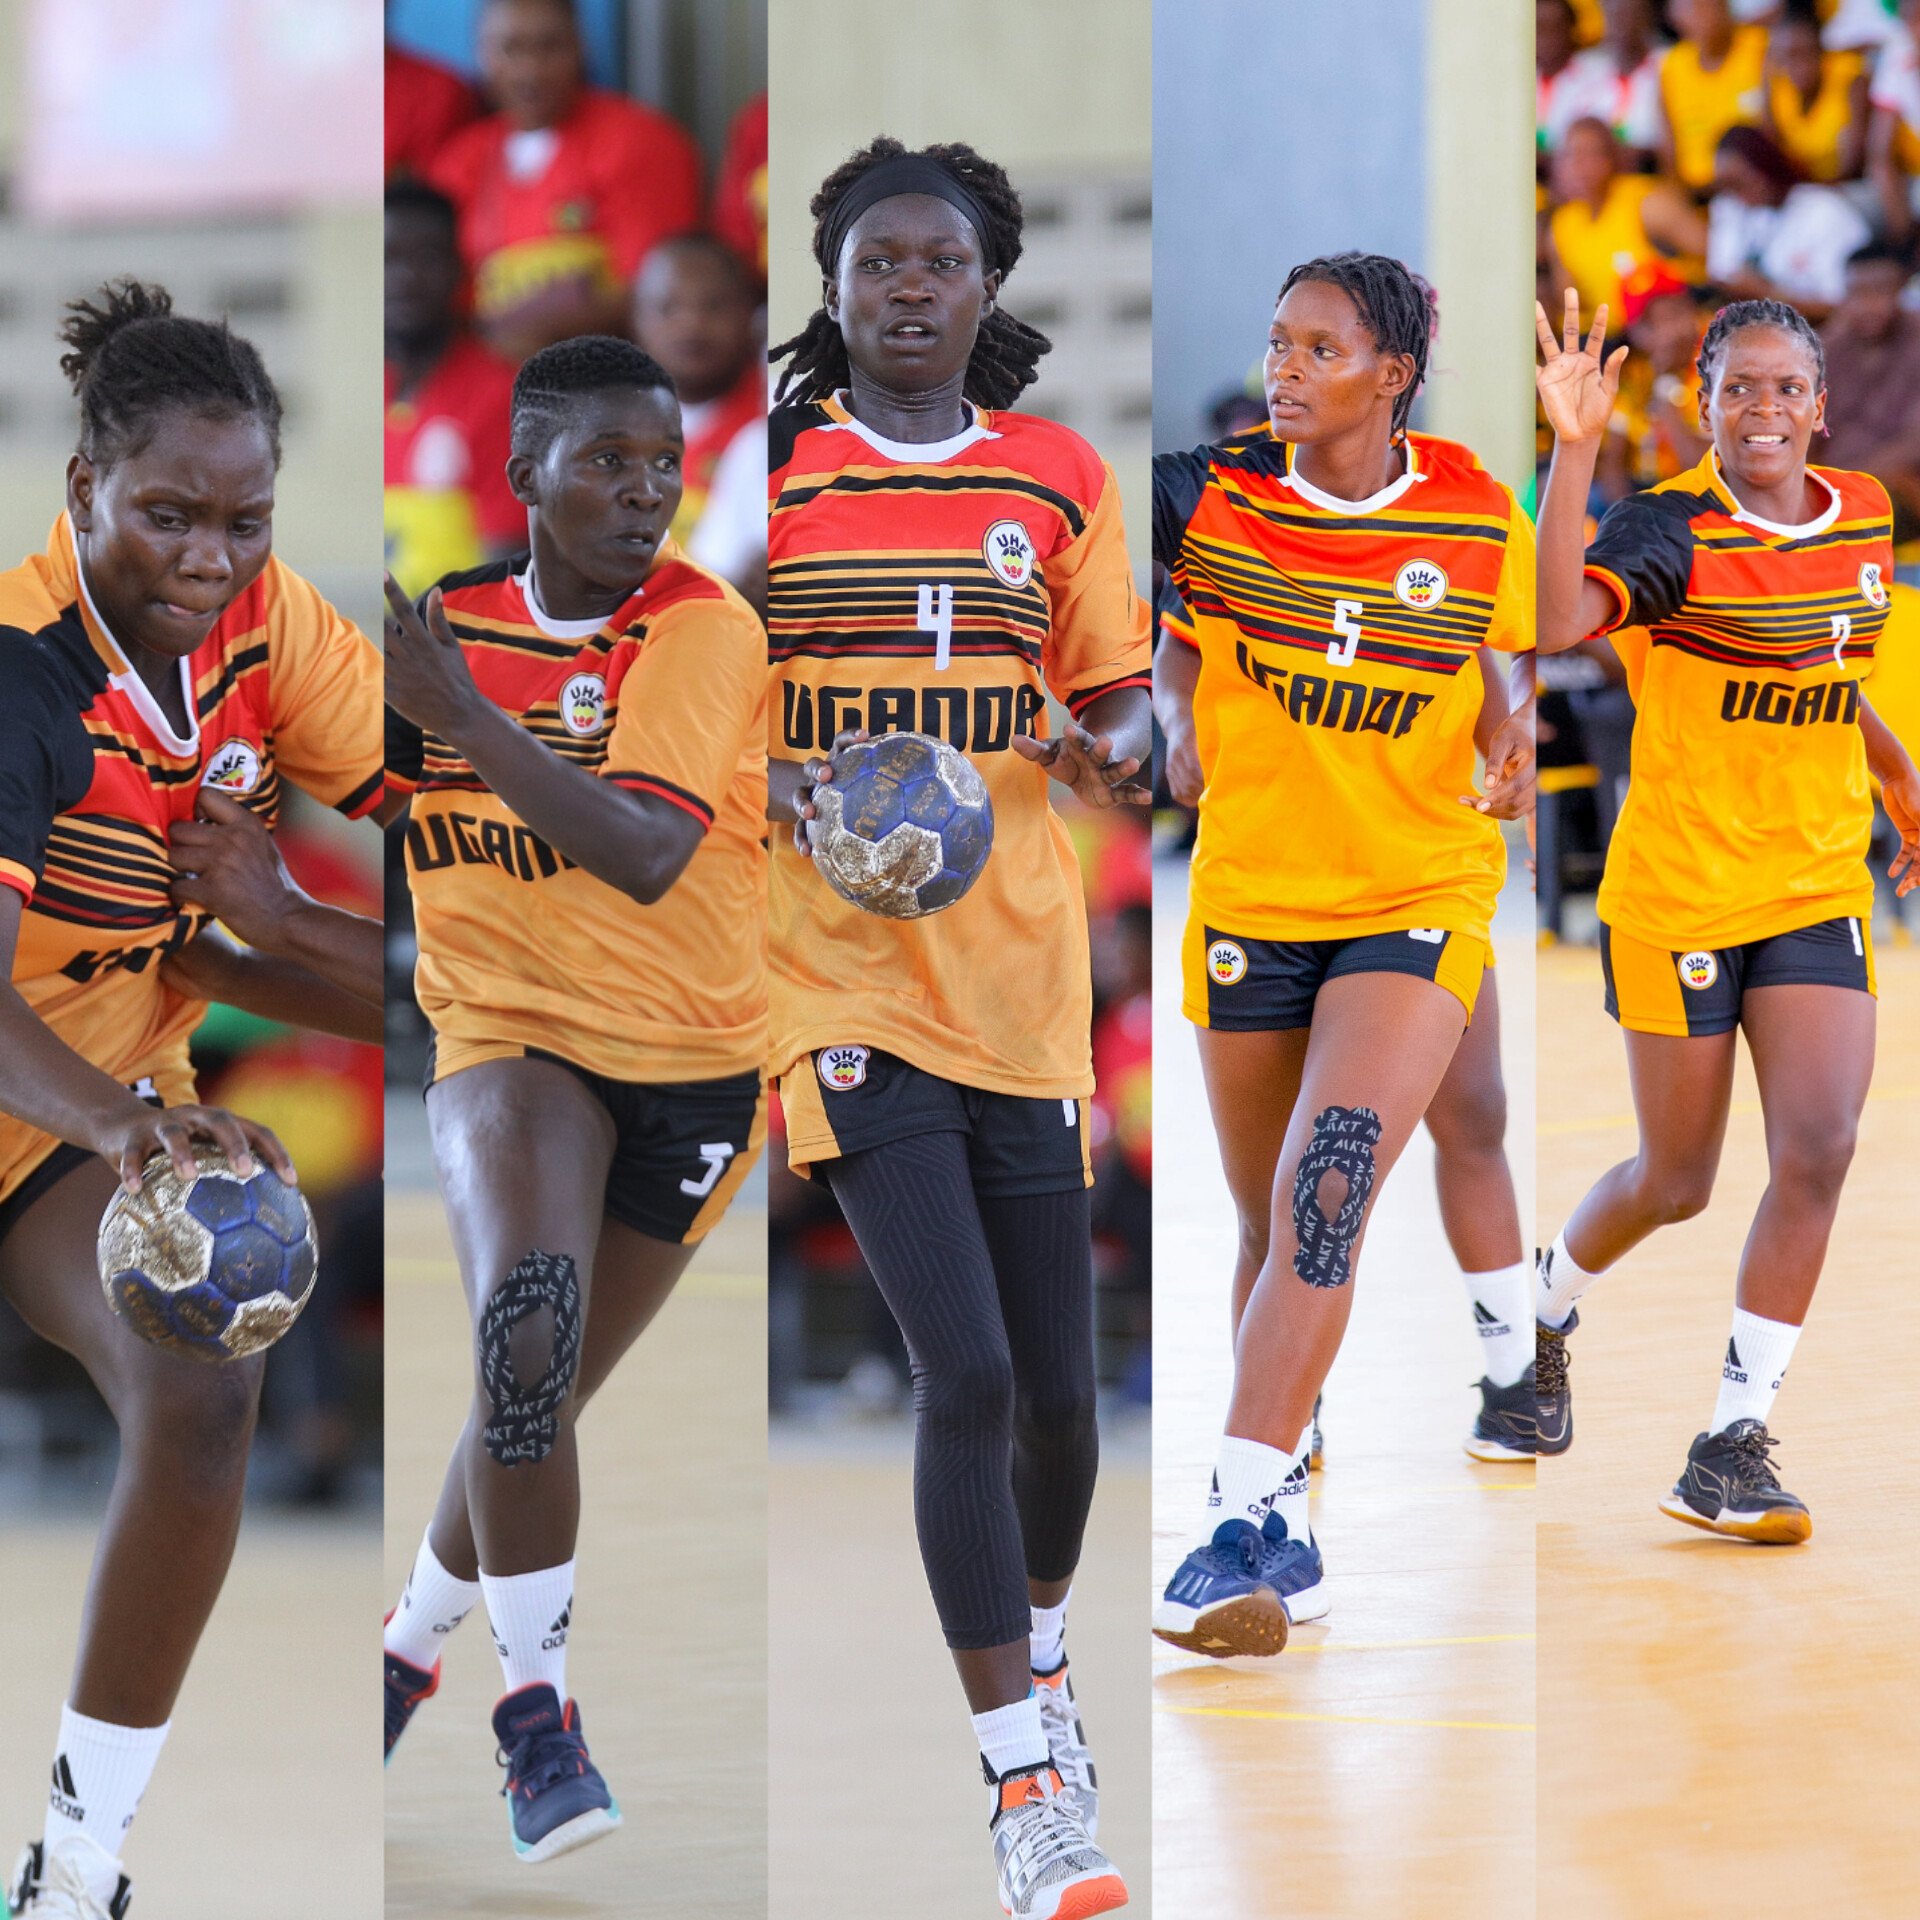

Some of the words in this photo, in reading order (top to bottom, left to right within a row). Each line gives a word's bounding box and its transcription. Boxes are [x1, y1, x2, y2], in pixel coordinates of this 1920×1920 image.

[996, 534, 1029, 554] UHF
[1406, 570, 1439, 585] UHF
[917, 583, 953, 671] 4
[1326, 600, 1363, 667] 5
[1830, 614, 1851, 671] 7
[570, 685, 605, 704] UHF
[782, 680, 1046, 753] UGANDA
[405, 811, 580, 882] UGAN
[1214, 949, 1239, 963] UHF
[1686, 957, 1712, 968] UHF
[829, 1050, 864, 1065] UHF
[1722, 1365, 1749, 1384] das
